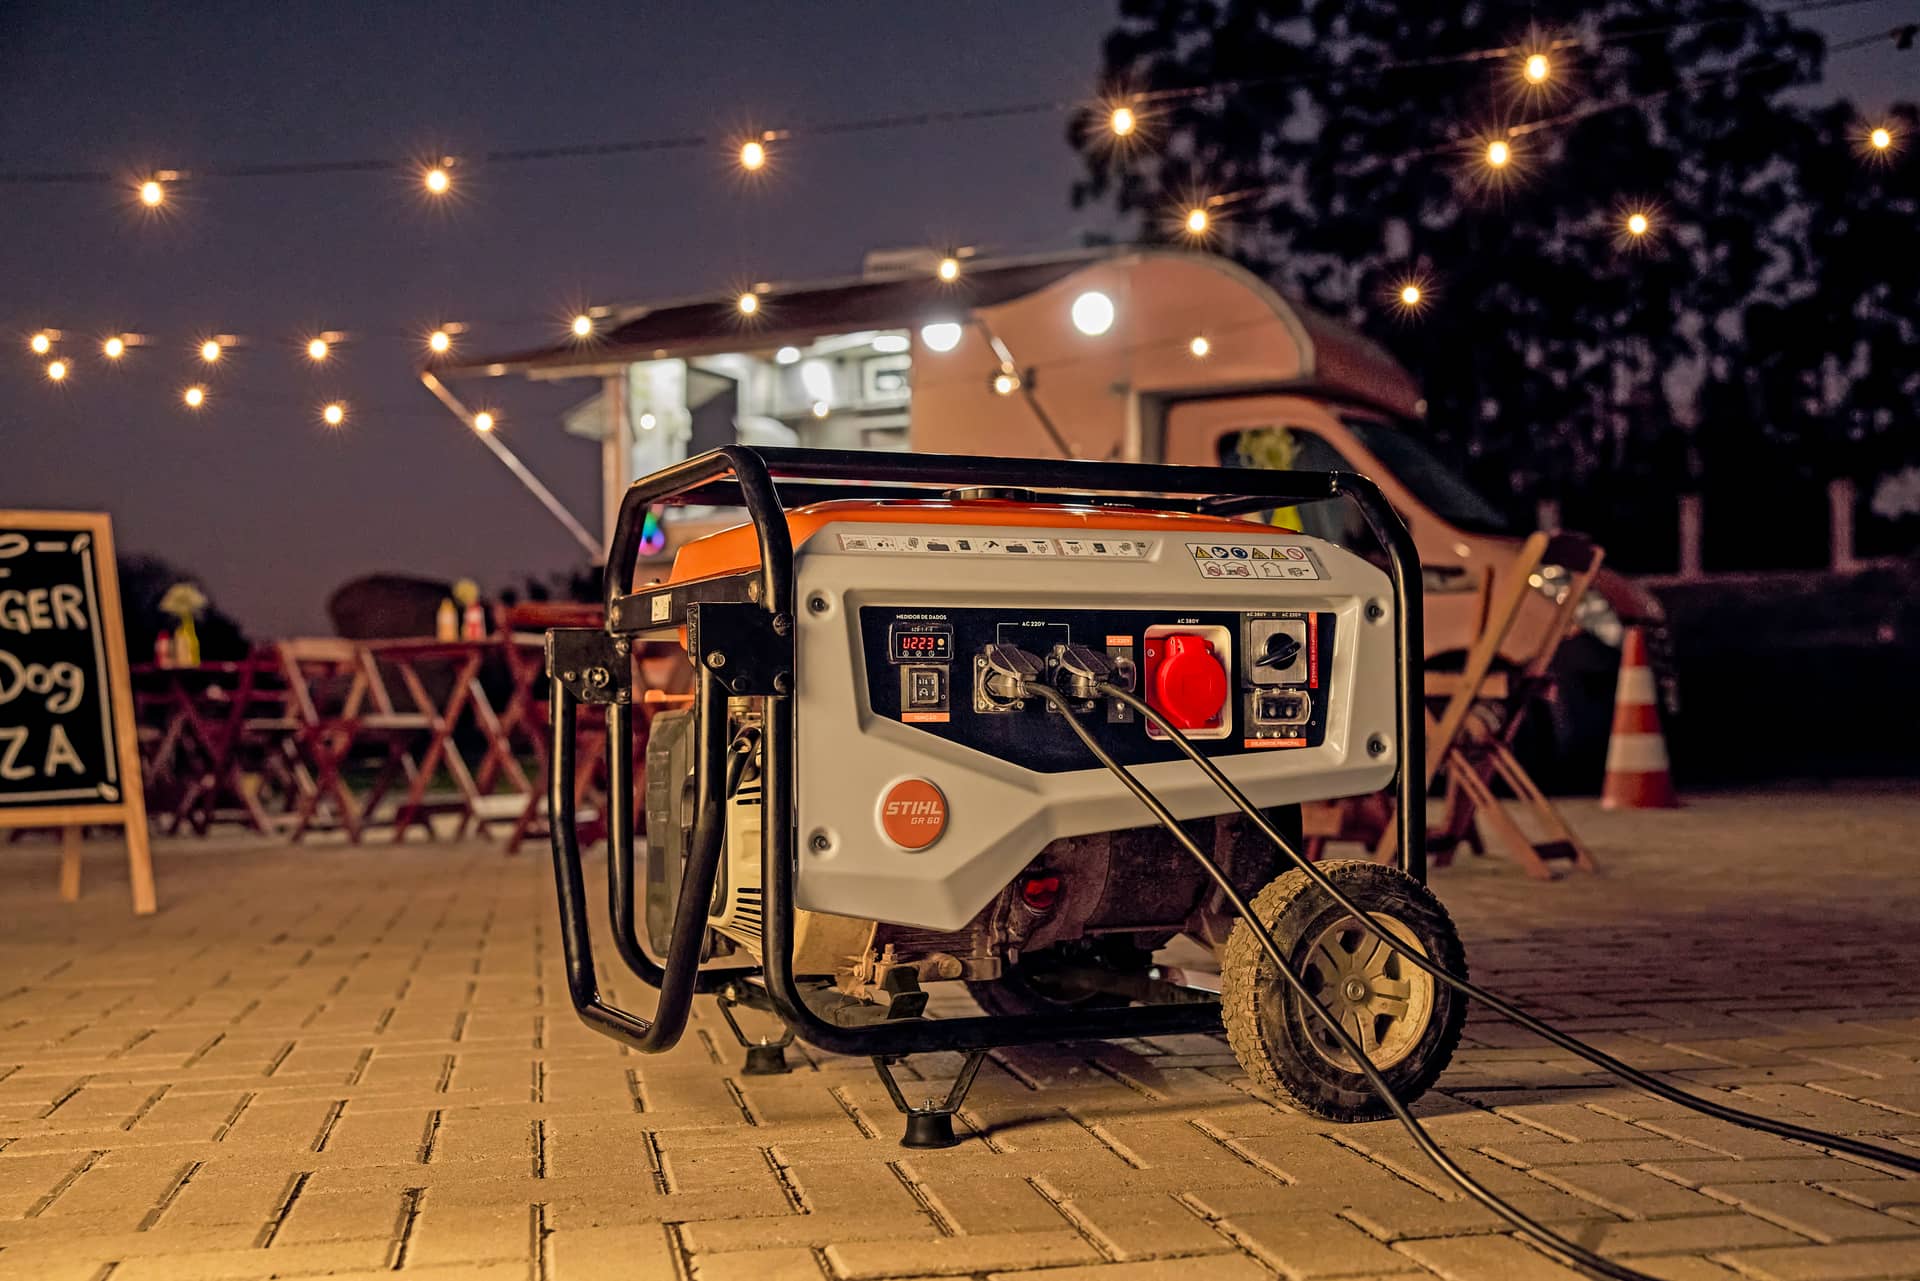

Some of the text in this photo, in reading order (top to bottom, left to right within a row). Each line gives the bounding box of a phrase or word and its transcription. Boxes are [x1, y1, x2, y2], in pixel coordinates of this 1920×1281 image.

[0, 649, 85, 714] Dog
[886, 800, 943, 816] STIHL
[910, 816, 941, 825] GR 60
